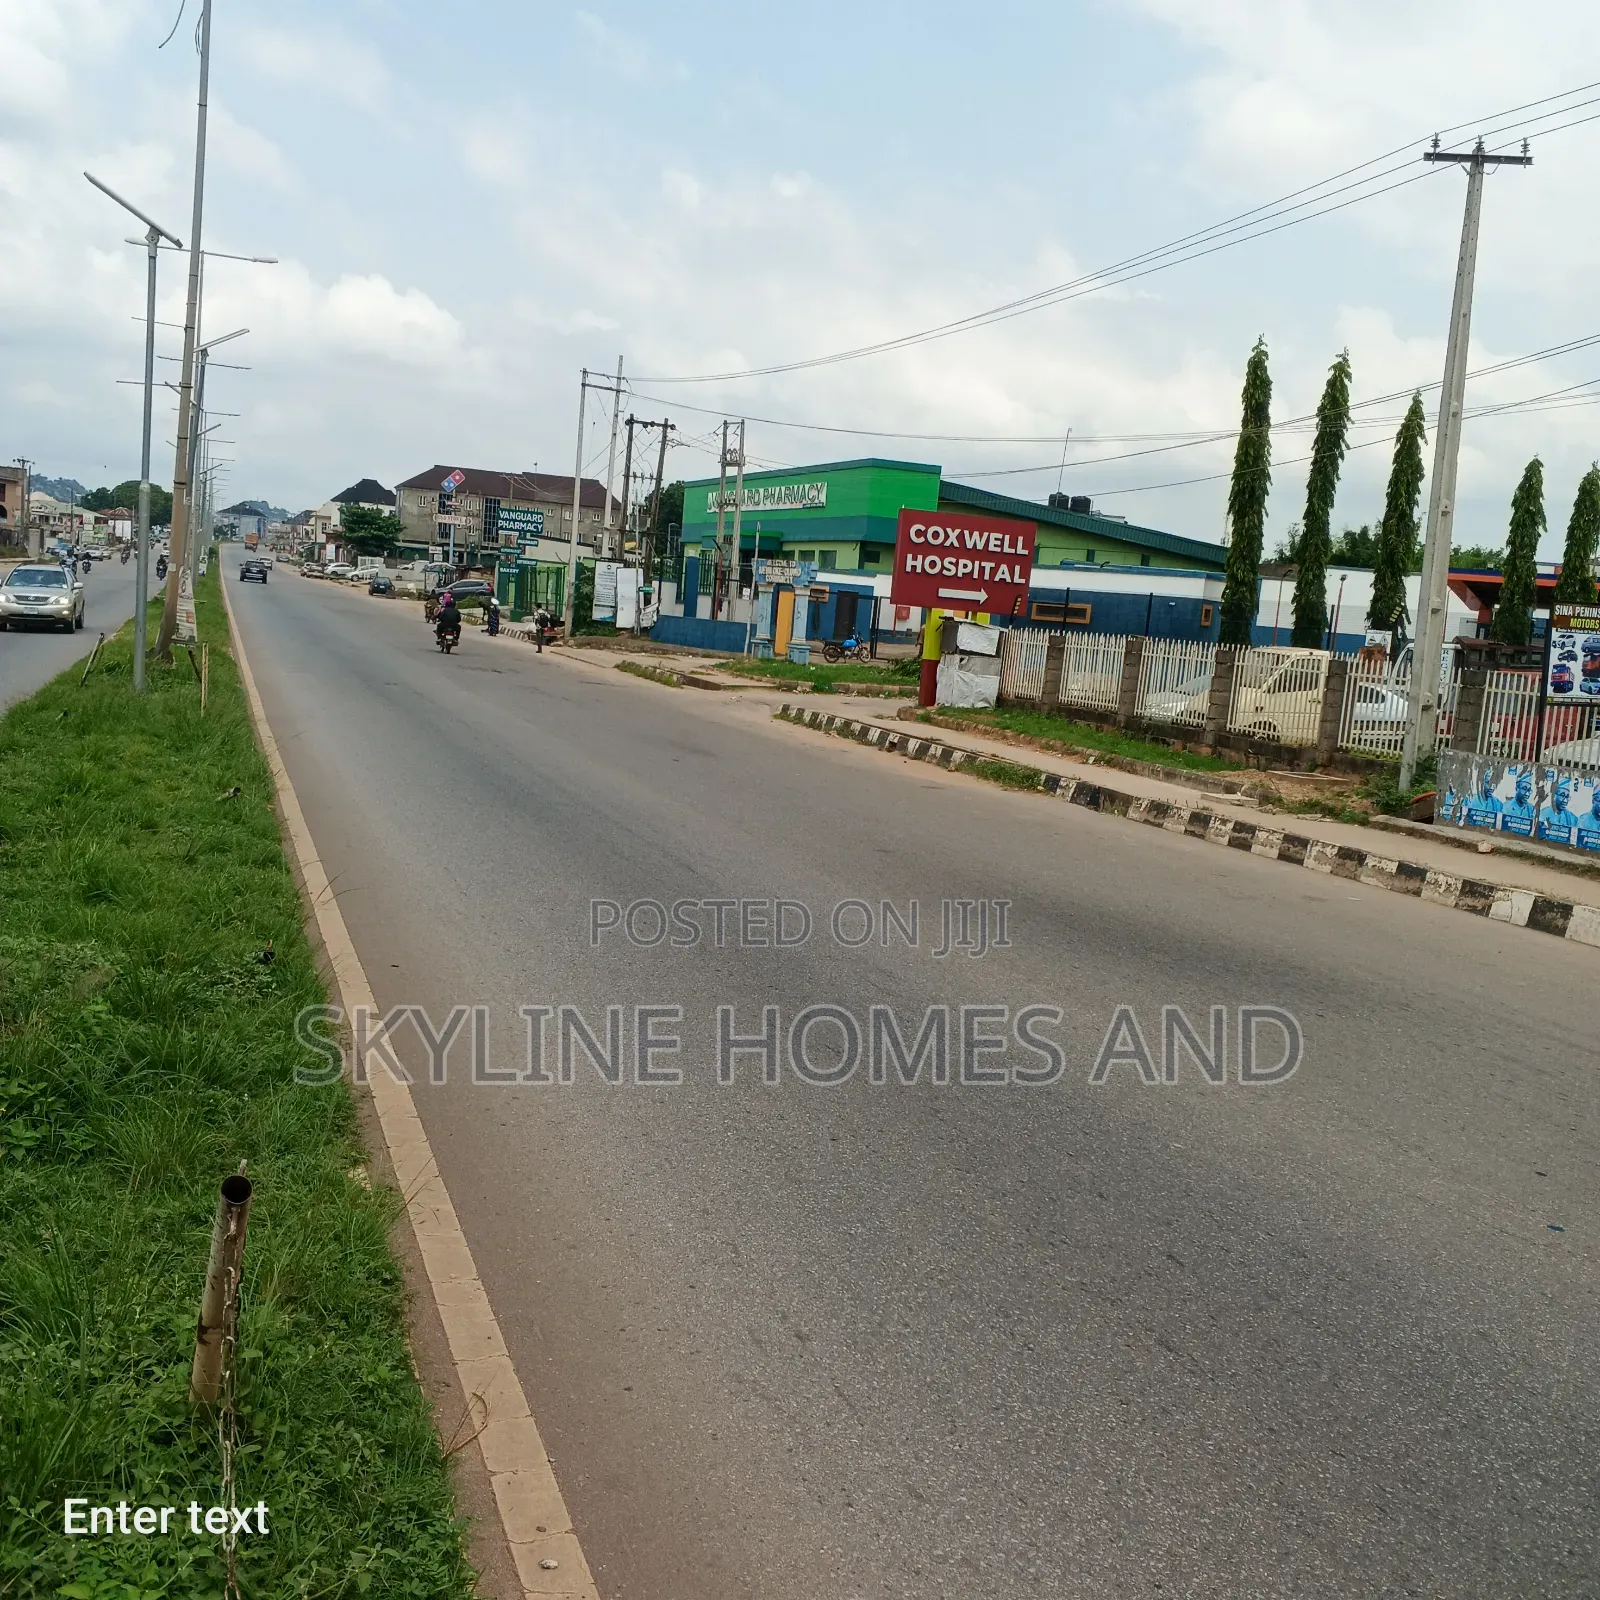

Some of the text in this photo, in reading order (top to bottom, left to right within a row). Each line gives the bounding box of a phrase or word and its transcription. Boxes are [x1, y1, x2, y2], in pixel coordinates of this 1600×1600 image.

[762, 482, 824, 506] PHARMACY
[499, 510, 544, 522] VANGUARD
[498, 520, 543, 532] PHARMACY
[909, 523, 1029, 556] COXWELL
[905, 553, 1026, 584] HOSPITAL
[1554, 604, 1573, 617] SINA
[1569, 617, 1600, 630] MOTORS
